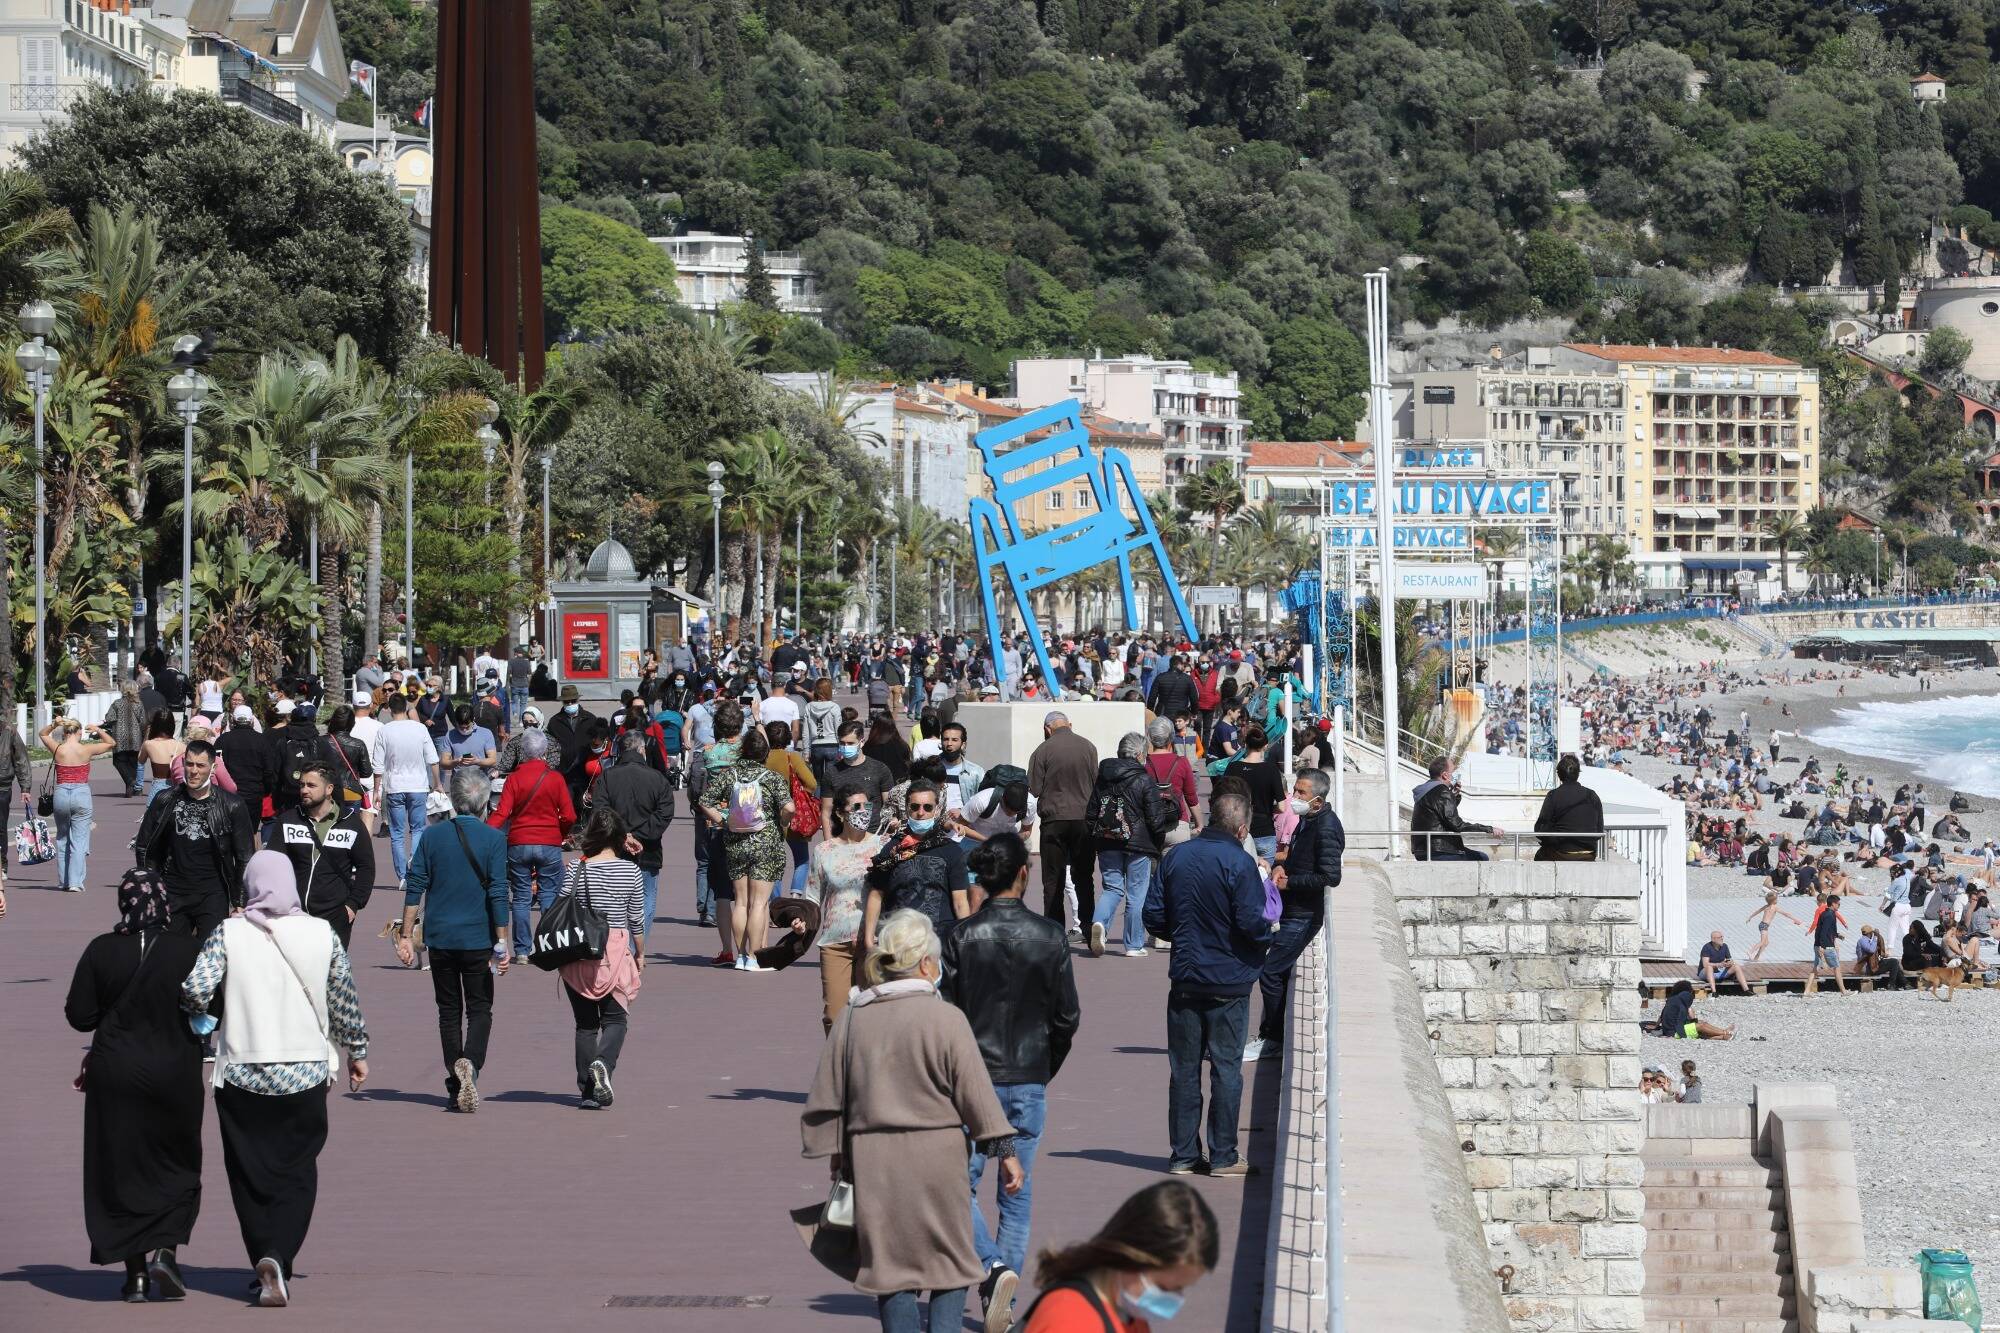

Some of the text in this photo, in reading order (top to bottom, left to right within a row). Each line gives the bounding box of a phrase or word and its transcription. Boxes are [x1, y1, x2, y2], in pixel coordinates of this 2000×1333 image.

[1405, 448, 1474, 466] PLAGE
[1333, 480, 1550, 514] BEU RIVAGE
[1394, 527, 1467, 547] RIVAGE
[1403, 575, 1479, 587] RESTAURANT
[1855, 611, 1936, 629] CASTEL
[530, 926, 585, 956] KNY
